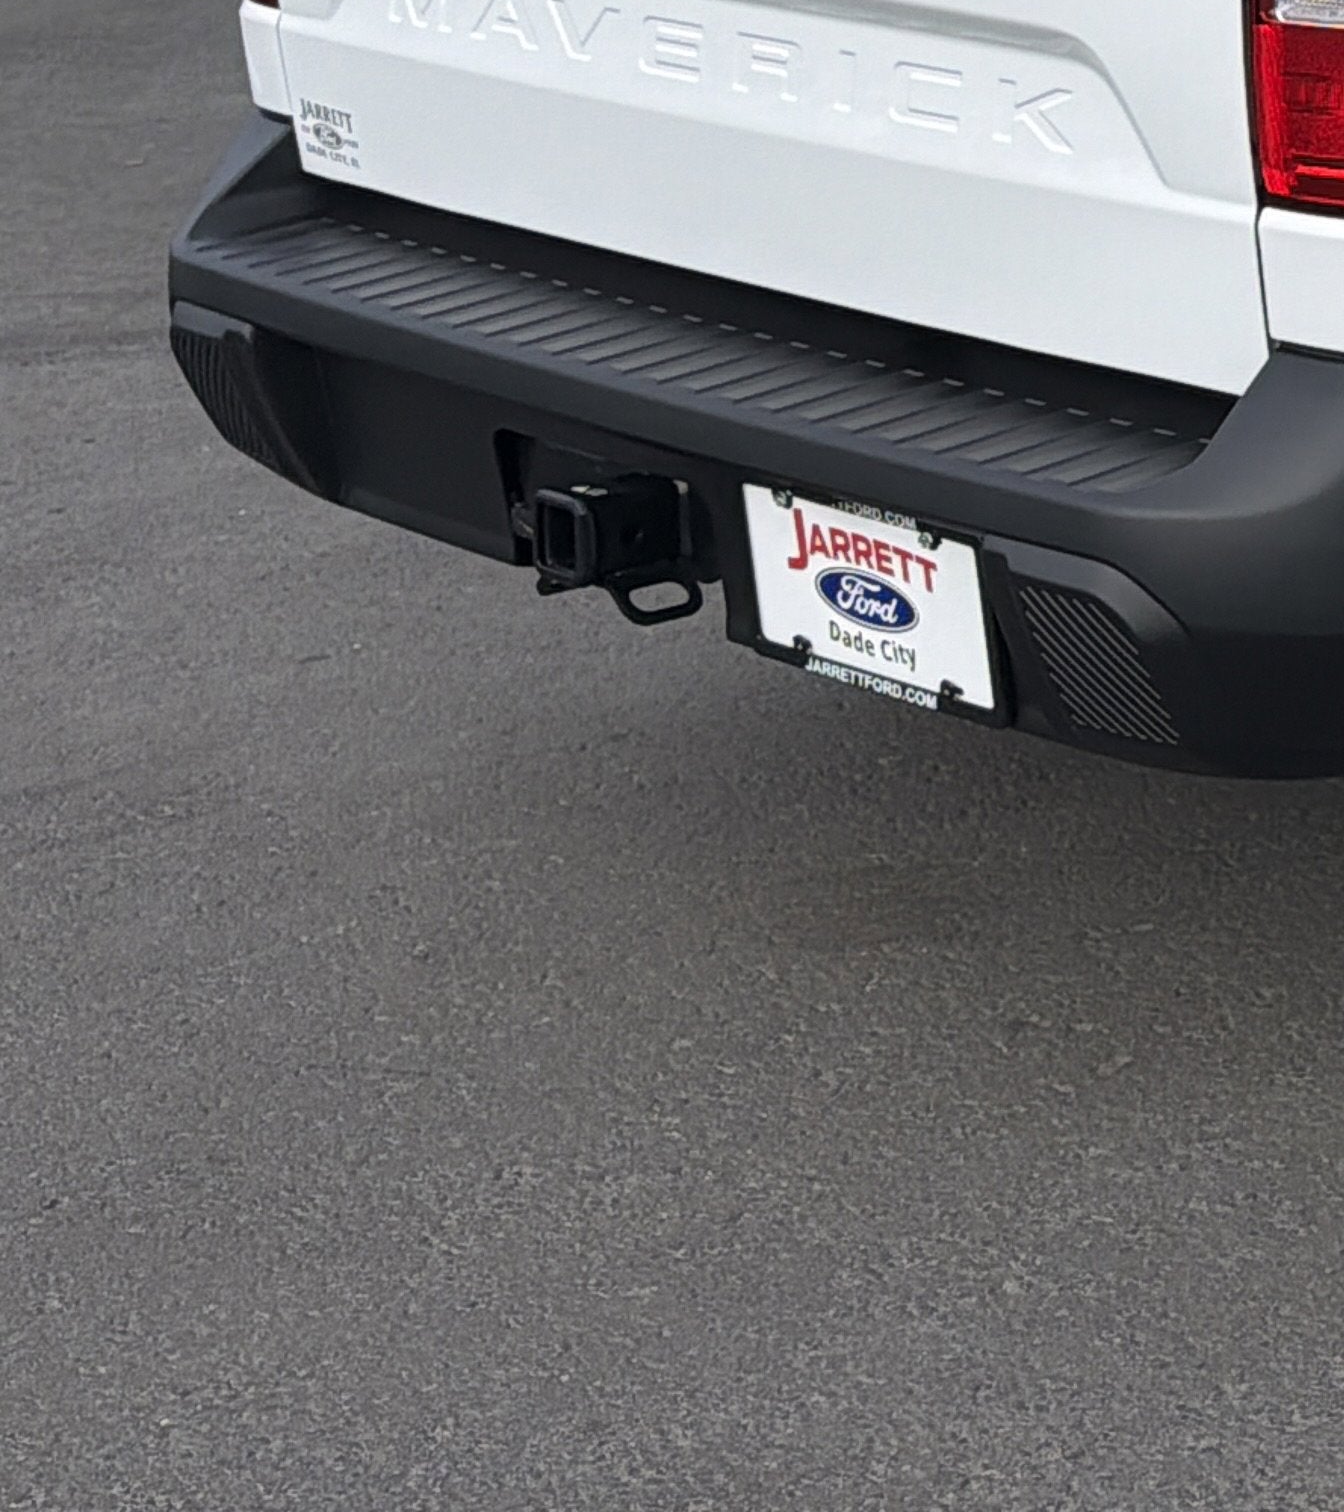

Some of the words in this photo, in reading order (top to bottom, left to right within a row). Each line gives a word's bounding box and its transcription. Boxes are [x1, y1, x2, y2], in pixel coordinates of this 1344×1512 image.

[786, 507, 938, 594] JARRETT
[836, 575, 899, 624] Ford
[829, 619, 876, 657] Dade
[880, 639, 917, 672] City
[804, 656, 938, 710] JARRETTFORD.COM
